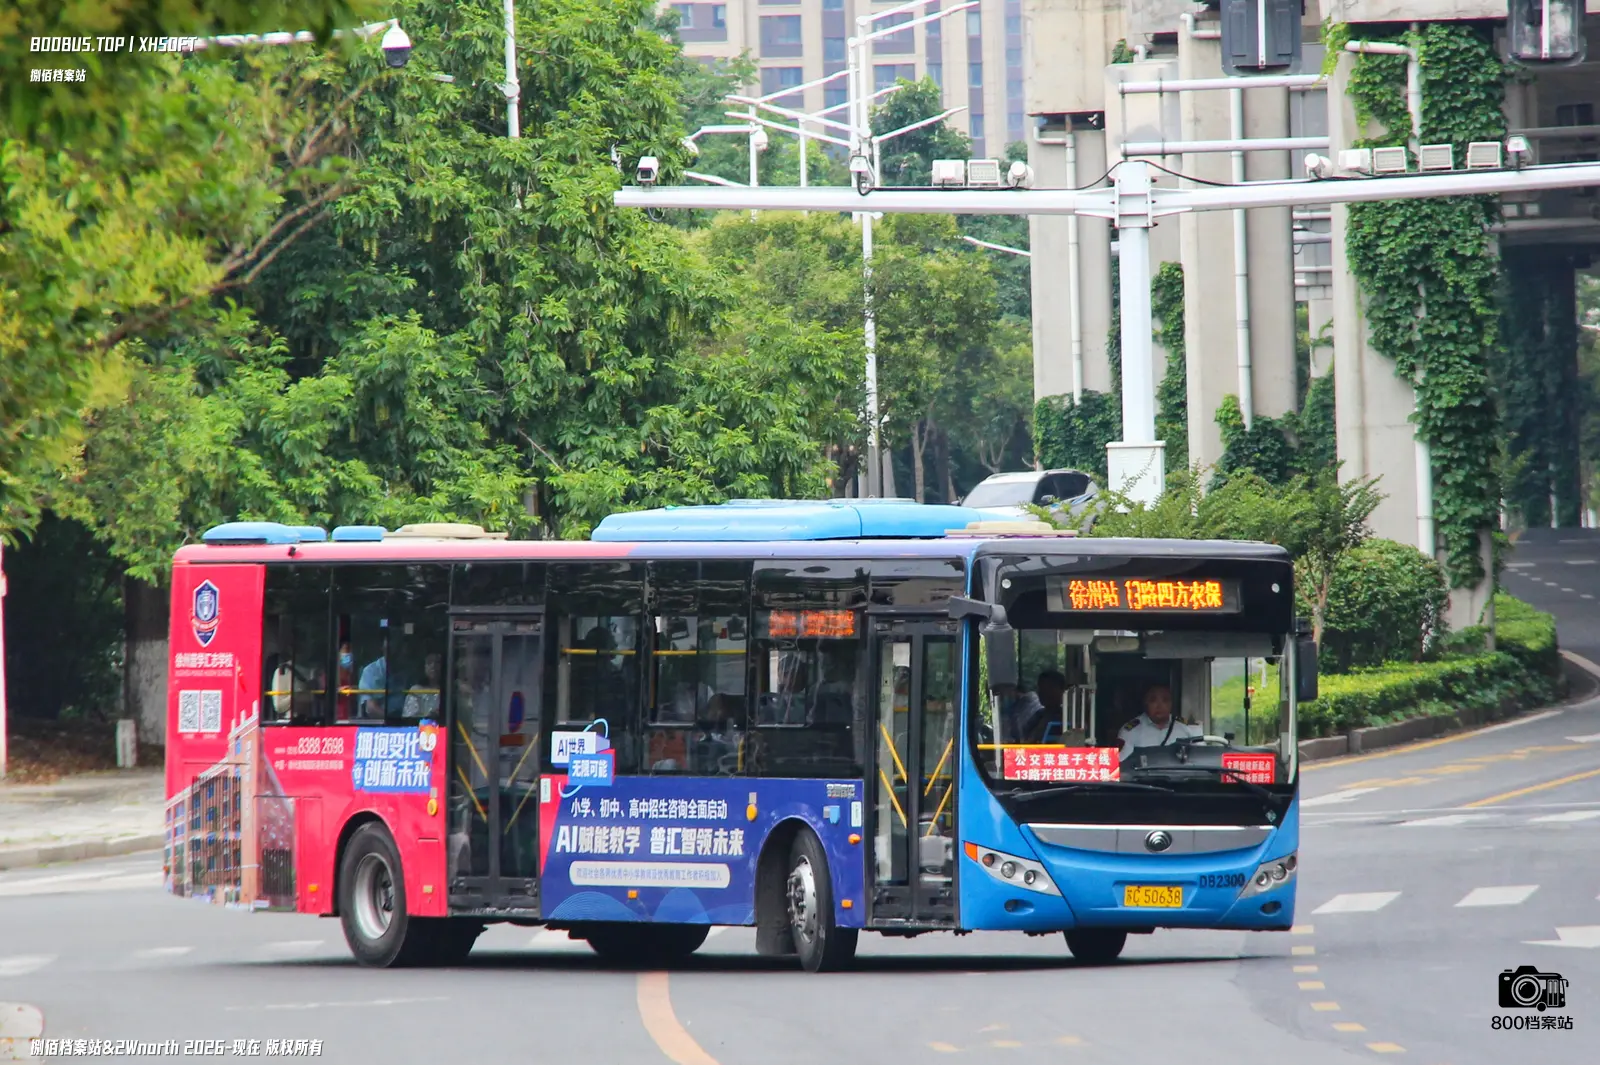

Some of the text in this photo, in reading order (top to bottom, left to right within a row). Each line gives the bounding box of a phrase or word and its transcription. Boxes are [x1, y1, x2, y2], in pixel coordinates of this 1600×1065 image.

[1069, 580, 1119, 609] 徐州站
[557, 738, 585, 756] AI世界
[571, 759, 608, 778] 无限可能
[1015, 753, 1110, 766] 公交菜篮子专线
[364, 760, 430, 787] 创新未来
[1015, 768, 1110, 781] 13路开往四方大集
[556, 825, 745, 856] AI赋能教学 普汇智领未来
